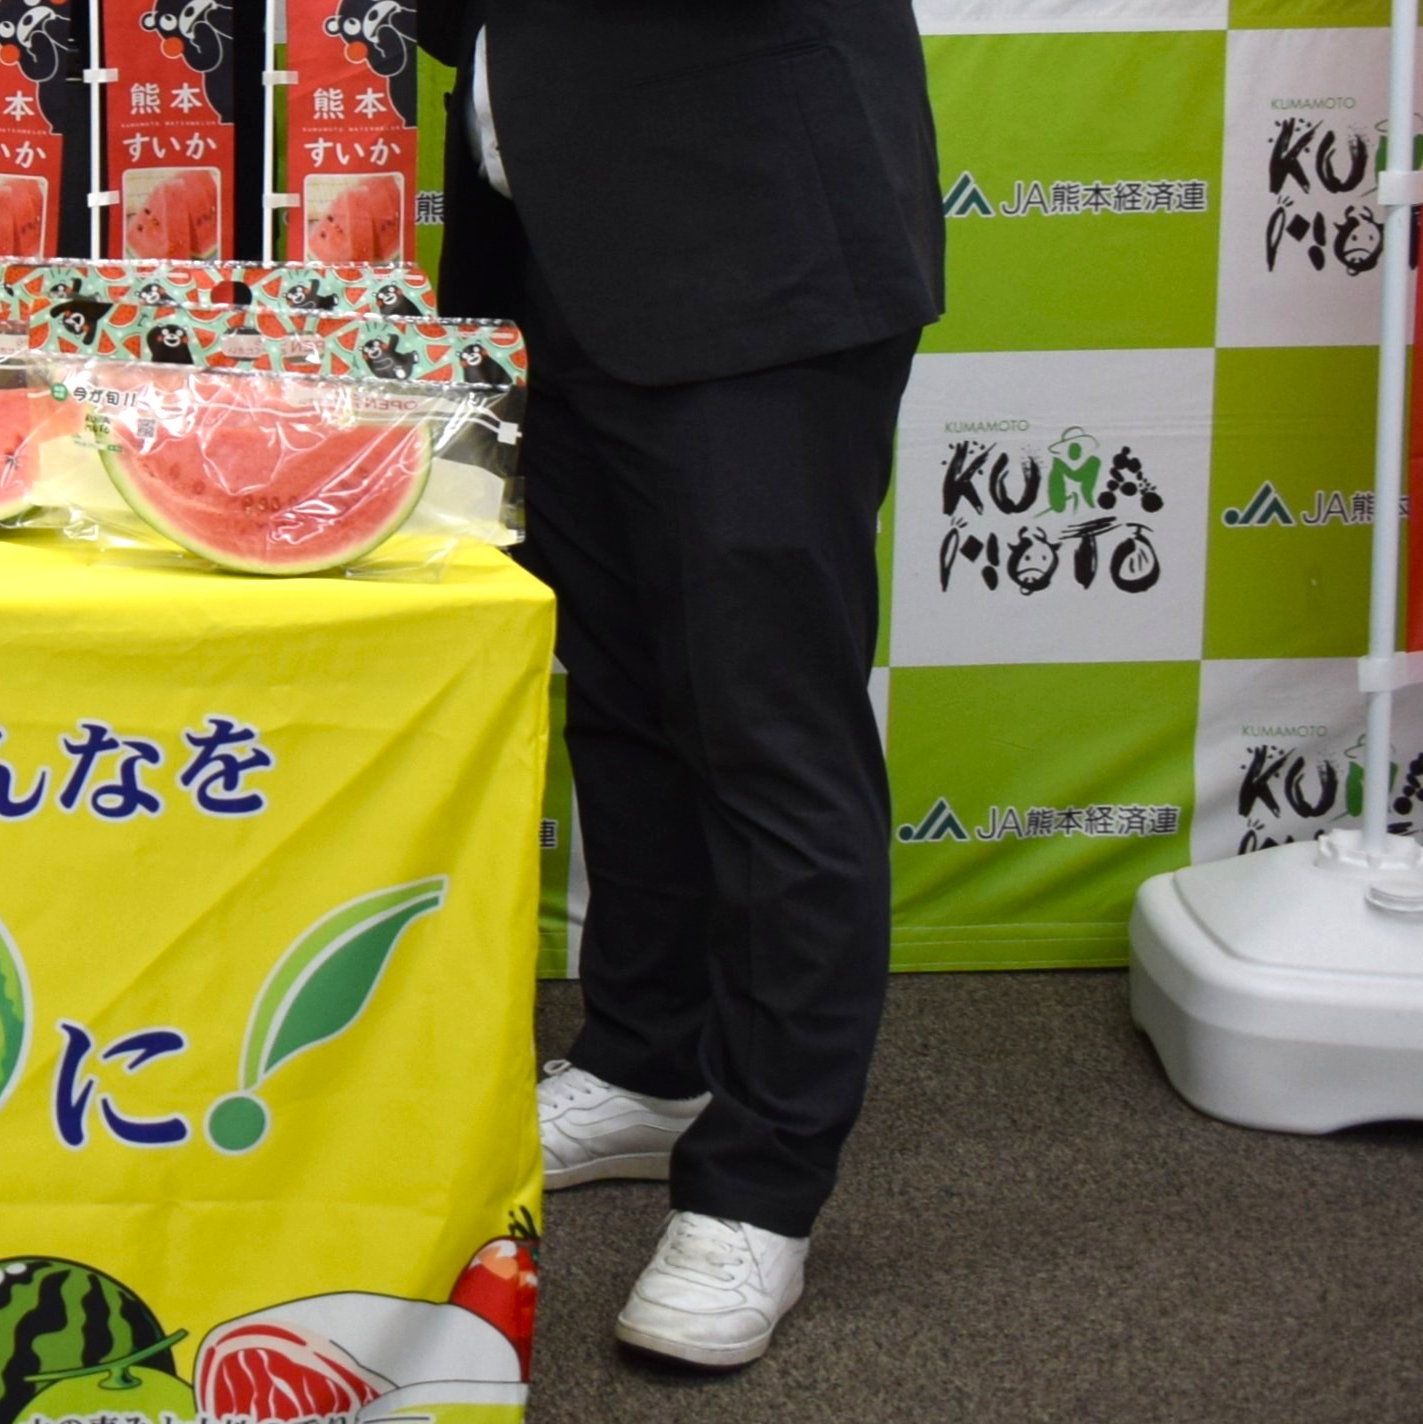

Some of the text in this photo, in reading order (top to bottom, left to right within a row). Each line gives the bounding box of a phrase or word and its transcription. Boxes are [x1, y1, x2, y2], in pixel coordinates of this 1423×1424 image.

[130, 82, 203, 115] 熊本
[313, 87, 387, 120] 熊本
[1271, 98, 1355, 110] KUMAMOTO
[122, 132, 217, 162] すいか
[303, 137, 401, 168] すいか
[1269, 116, 1380, 198] KU
[1004, 178, 1204, 214] JA熊本経済連
[1267, 196, 1384, 276] MO
[944, 419, 1029, 431] KUMAMOTO
[941, 426, 1163, 517] KUMA
[941, 518, 1161, 596] MOTO
[1241, 725, 1327, 737] KUMAMOTO
[978, 807, 1177, 839] JA熊本経済連
